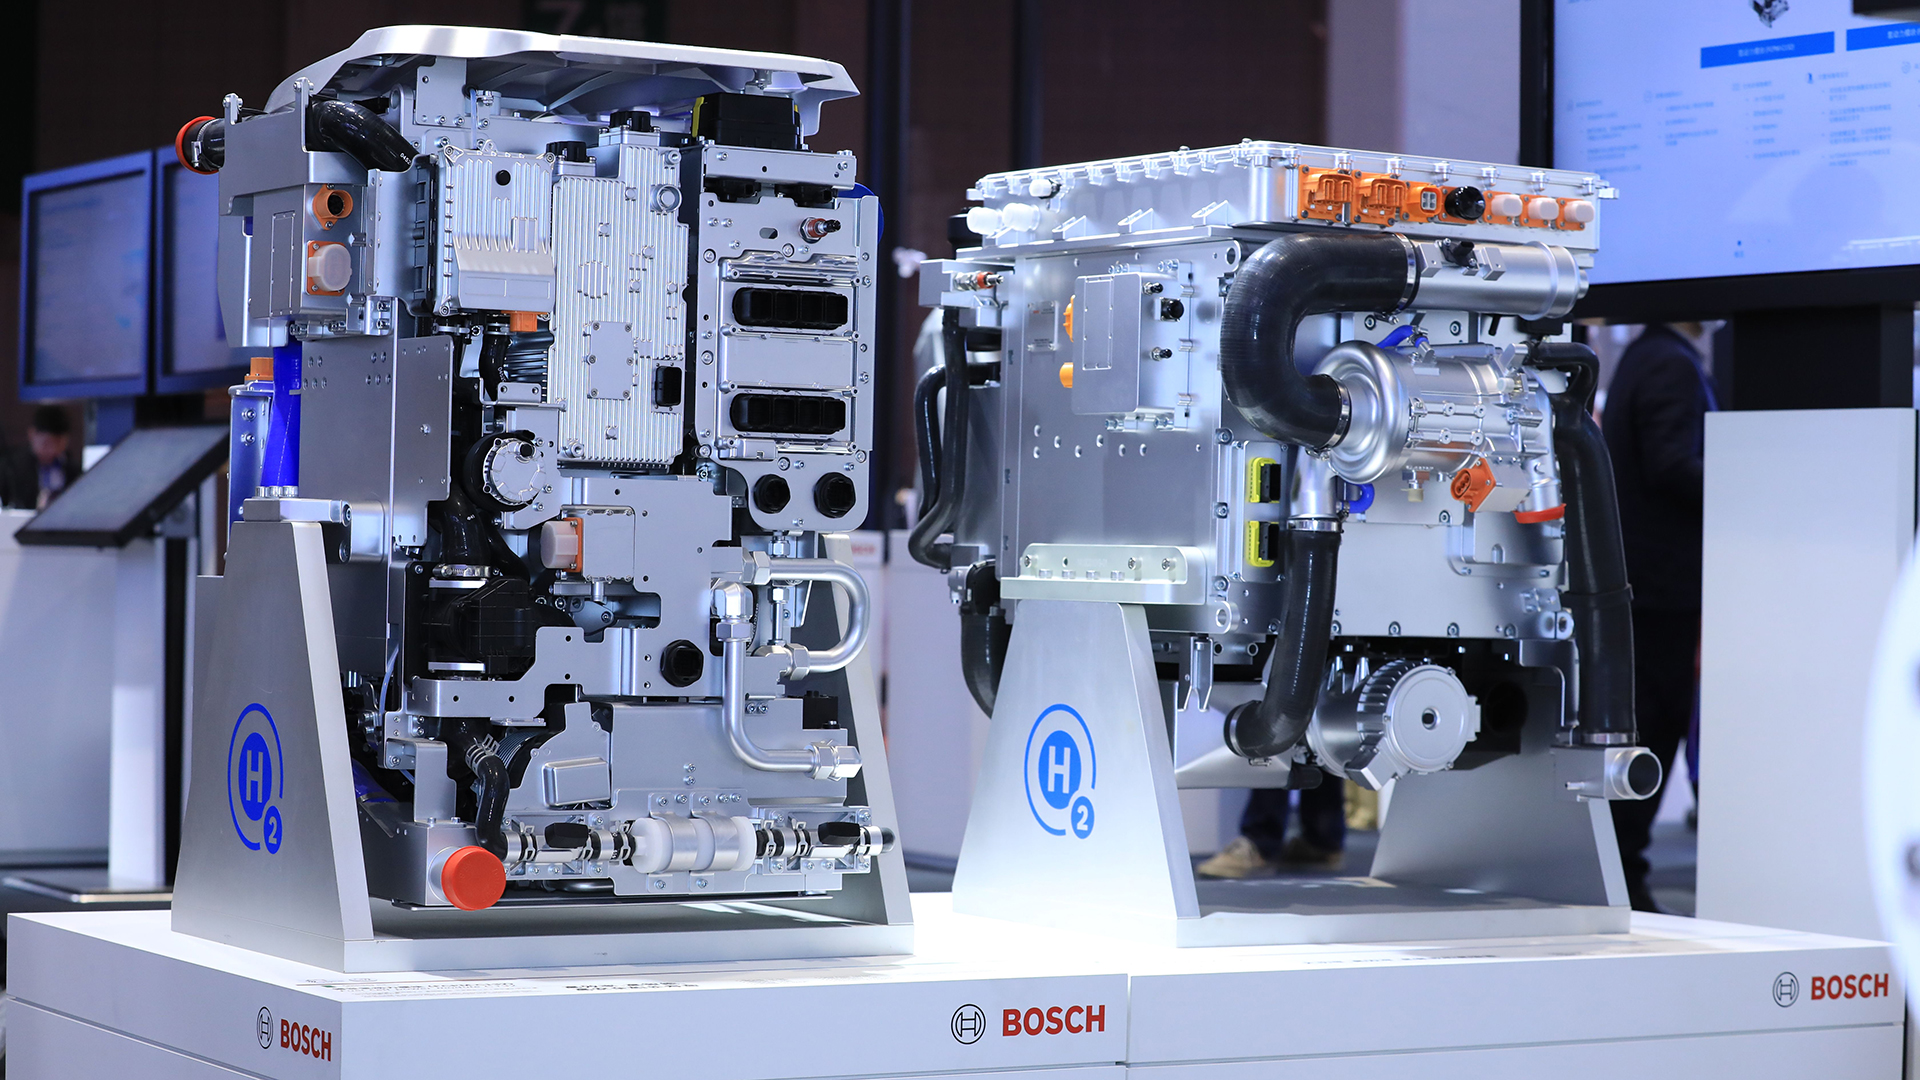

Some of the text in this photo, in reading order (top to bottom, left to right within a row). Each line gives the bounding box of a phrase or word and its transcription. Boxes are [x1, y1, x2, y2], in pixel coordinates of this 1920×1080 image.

[1811, 973, 1889, 1001] BOSCH
[1002, 1004, 1106, 1037] BOSCH
[280, 1018, 332, 1062] BOSCH
